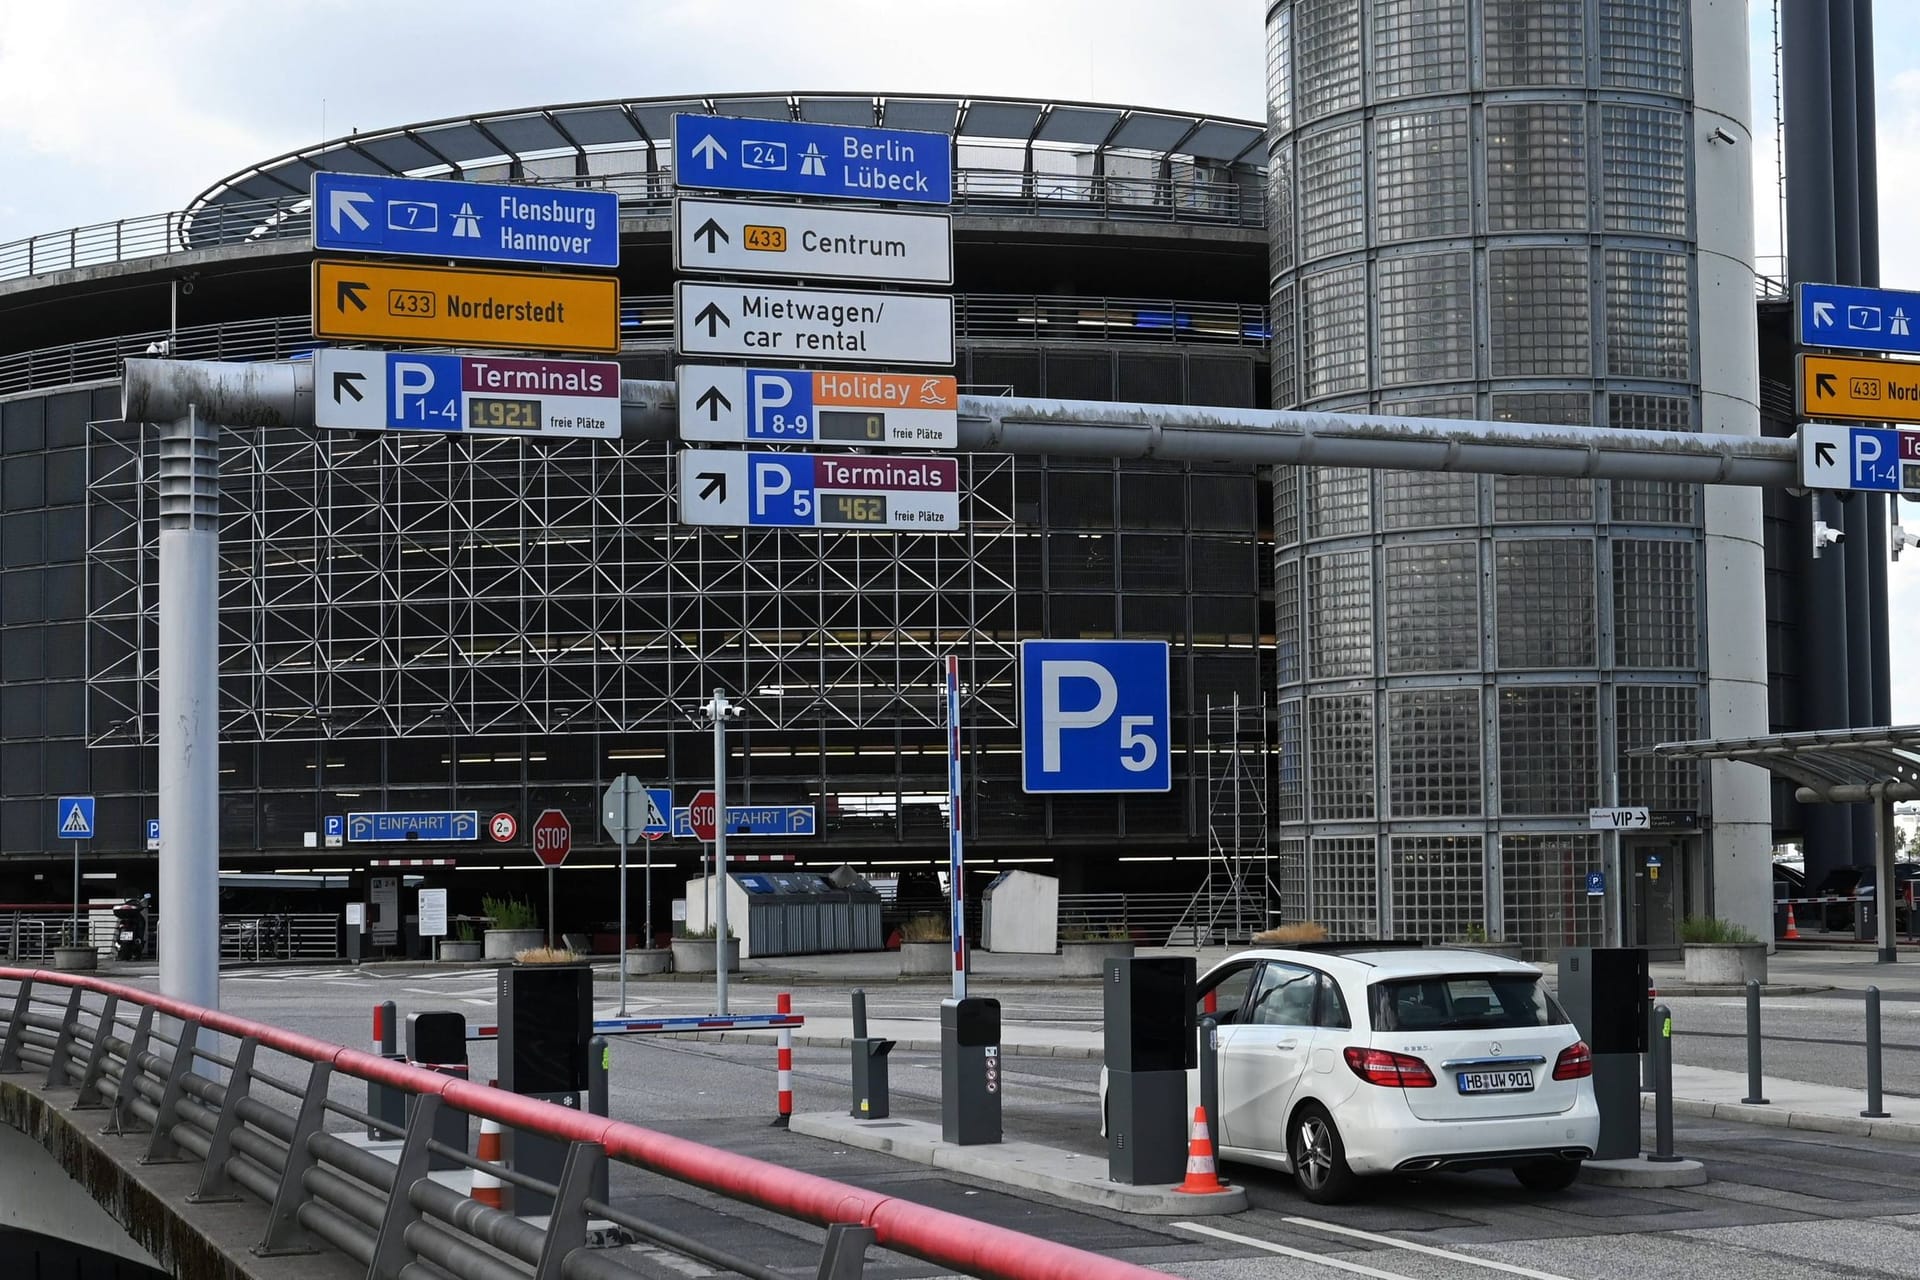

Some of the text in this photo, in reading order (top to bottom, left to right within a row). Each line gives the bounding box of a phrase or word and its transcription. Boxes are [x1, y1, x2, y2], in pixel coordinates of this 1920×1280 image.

[753, 148, 775, 164] 24
[844, 136, 914, 163] Berlin
[844, 166, 928, 192] Lübeck
[407, 208, 418, 225] 7
[500, 197, 596, 230] Flensburg
[501, 227, 591, 254] Hannover
[748, 230, 905, 257] 433 Centrum
[394, 295, 564, 323] 433 Norderstedt
[742, 296, 884, 326] Mietwagen/
[1860, 311, 1868, 325] 7
[743, 330, 866, 351] car rental
[471, 363, 603, 392] Terminals
[395, 362, 457, 422] P 1-4
[821, 376, 910, 405] Holiday
[1853, 381, 1920, 401] 433 Nord
[474, 403, 536, 427] 1921
[754, 375, 808, 434] P 8-9
[551, 417, 605, 430] freie Plätze
[867, 416, 880, 438] 0
[893, 428, 942, 440] freie Plätze
[1855, 435, 1897, 483] P 1-4
[822, 462, 942, 486] Terminals
[756, 462, 812, 516] P 5
[839, 498, 881, 520] 462
[894, 510, 944, 522] freie Plätze
[1042, 660, 1157, 772] P 5
[329, 819, 338, 834] P
[355, 816, 468, 838] P EINFAHRT P
[497, 822, 502, 832] 2
[693, 806, 715, 826] STO
[726, 811, 780, 824] NFAHRT
[793, 816, 805, 831] P
[1612, 811, 1632, 826] VIP
[150, 822, 158, 837] P
[538, 828, 567, 849] STOP
[1466, 1072, 1532, 1089] HB UW 901
